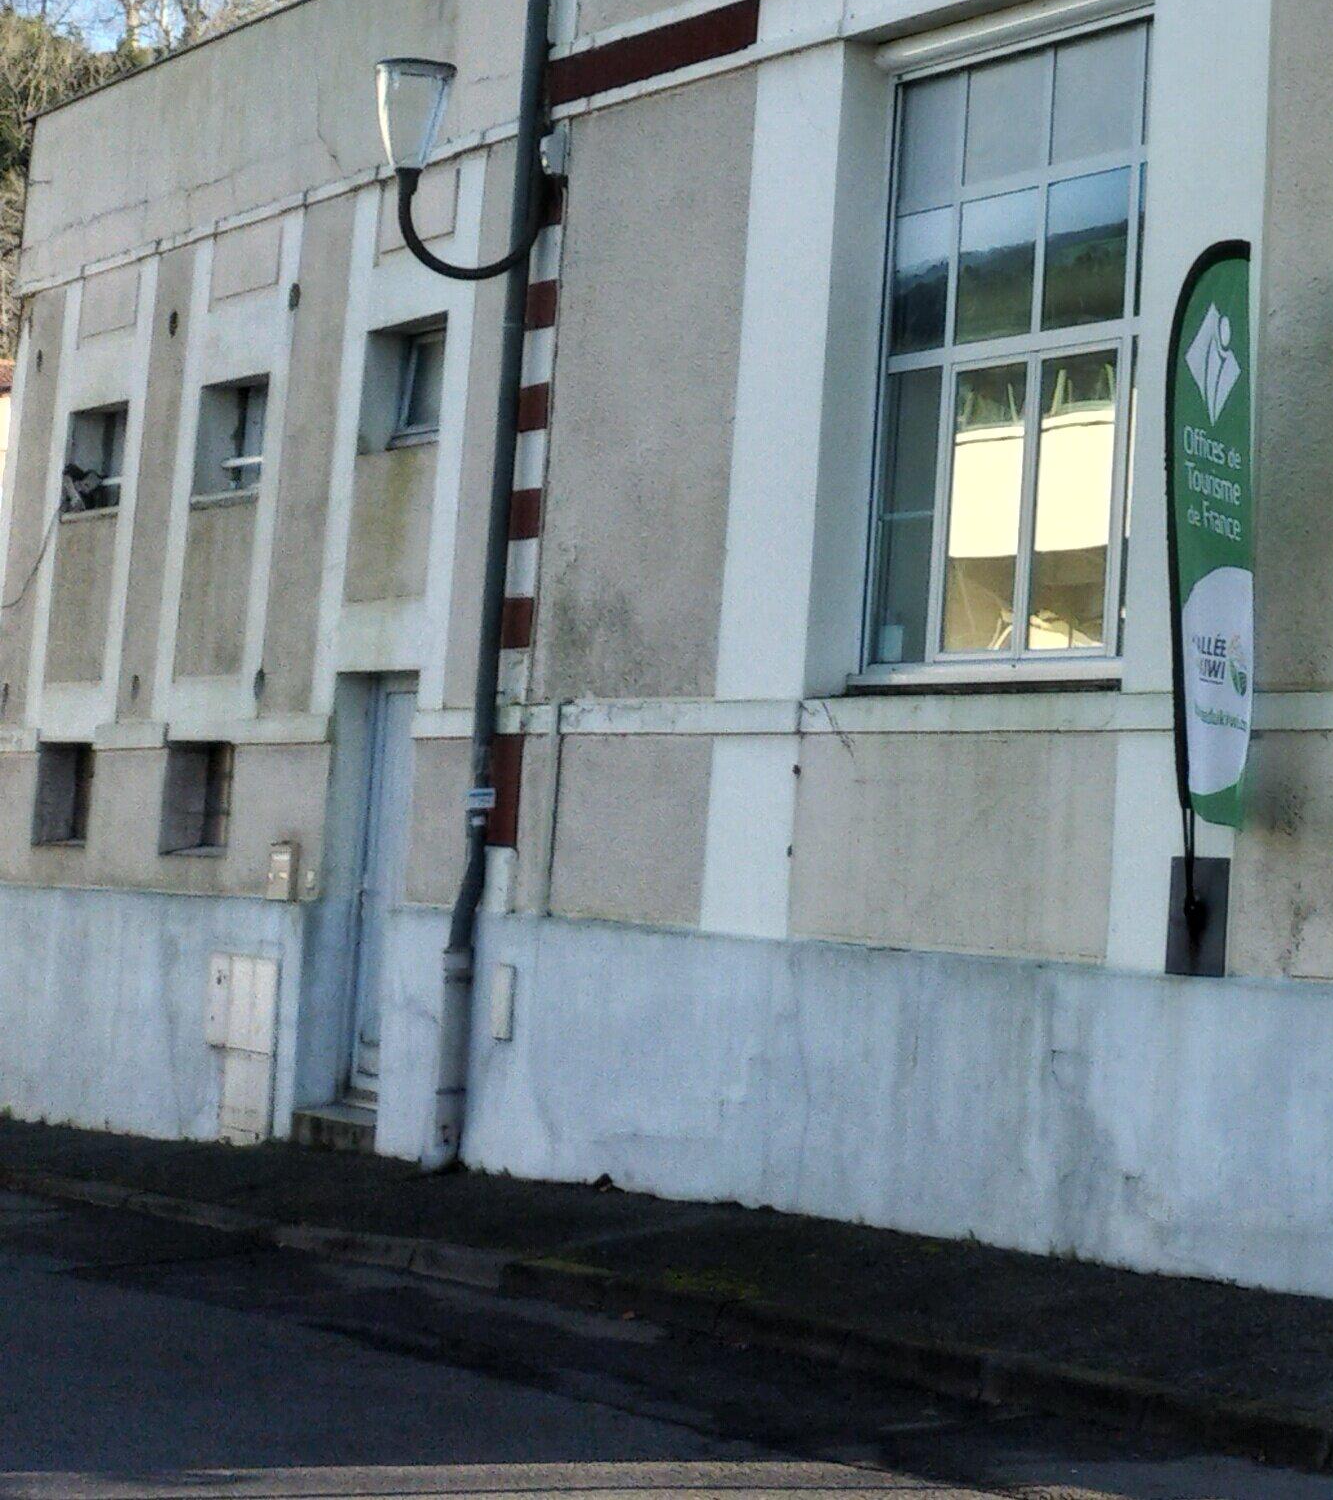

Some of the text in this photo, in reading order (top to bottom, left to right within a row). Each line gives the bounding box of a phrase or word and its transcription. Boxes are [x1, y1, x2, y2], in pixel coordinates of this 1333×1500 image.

[1183, 425, 1241, 470] Offices de
[1184, 459, 1241, 506] Tourisme
[1187, 500, 1242, 542] de France
